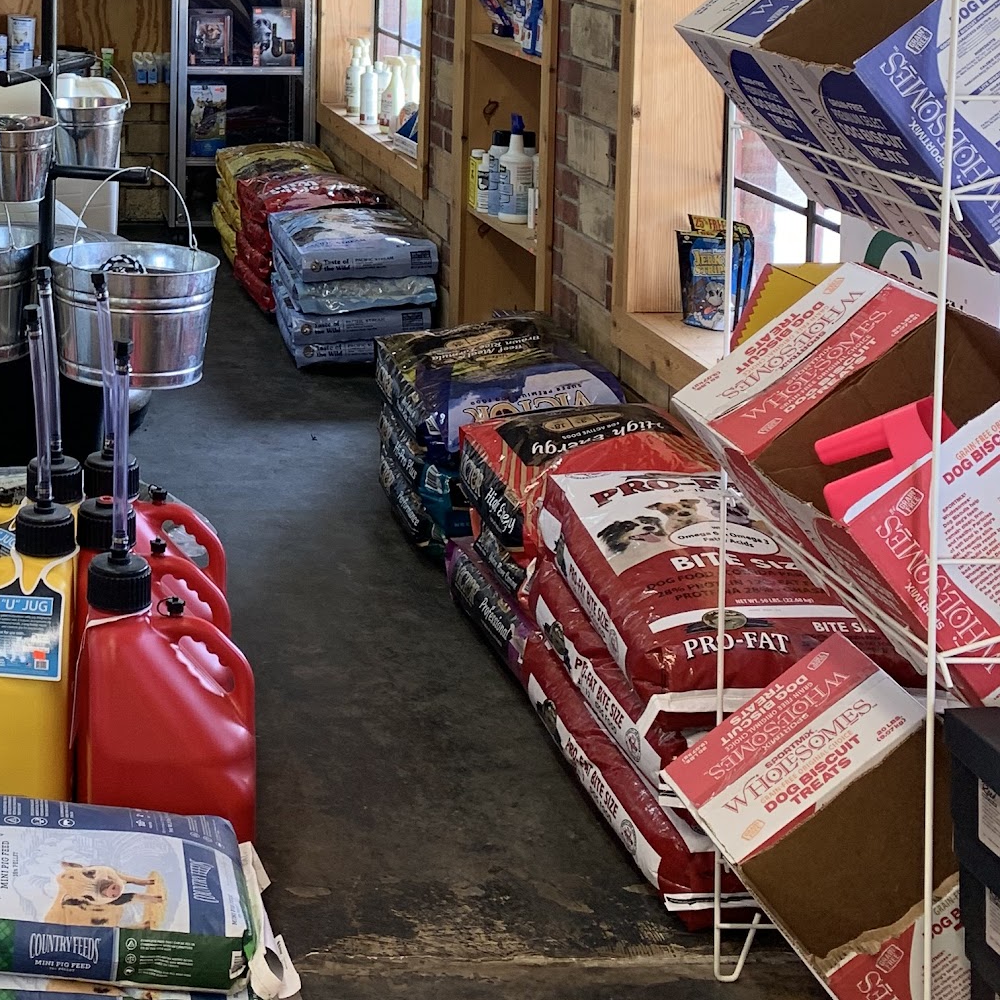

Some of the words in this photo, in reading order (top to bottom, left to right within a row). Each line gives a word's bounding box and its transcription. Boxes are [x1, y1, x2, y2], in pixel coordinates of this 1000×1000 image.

[908, 28, 926, 50] GRAIN
[914, 36, 930, 54] FREE
[794, 301, 824, 328] DOG
[717, 291, 866, 399] WHOLESOMES
[745, 312, 796, 355] TREATS
[845, 334, 872, 359] CHOICE
[735, 328, 793, 375] BISCUIT
[741, 310, 893, 420] WHOLESOMES
[562, 430, 581, 440] DOGS
[582, 425, 606, 436] ACTIVE
[606, 421, 621, 429] FOR
[612, 420, 665, 437] High
[942, 458, 974, 485] DOG
[398, 491, 420, 528] Performance
[485, 487, 500, 514] High
[899, 490, 916, 510] GRAIN
[677, 531, 711, 541] Omega
[730, 532, 763, 545] Omega
[730, 538, 755, 548] Acids
[670, 552, 745, 572] BITE
[646, 576, 676, 591] DOG
[678, 571, 714, 583] FOOD
[22, 601, 48, 612] JUG
[479, 597, 512, 641] Professional
[586, 590, 598, 612] BITE
[597, 608, 610, 632] SIZE
[812, 620, 849, 632] BITE
[683, 631, 790, 660] PRO-FAT
[574, 656, 598, 693] PRO-FAT
[596, 685, 610, 710] BITE
[610, 700, 624, 729] SIZE
[776, 674, 809, 701] DOG
[792, 681, 814, 698] GRAIN
[730, 683, 785, 726] TREATS
[778, 697, 793, 711] FREE
[705, 672, 850, 780] WHOLESOMES
[721, 701, 776, 747] BISCUIT
[750, 709, 778, 735] ORIGINAL
[761, 712, 809, 750] SPORTMIX
[876, 726, 887, 735] 20
[725, 732, 749, 752] CHOICE
[765, 729, 818, 769] SPORTMIX
[798, 750, 829, 777] ORIGINAL
[828, 730, 855, 751] CHOICE
[721, 699, 873, 814] WHOLESOMES
[564, 737, 593, 777] PRO-FAT
[591, 771, 605, 799] BITE
[604, 791, 619, 820] SIZE
[764, 783, 800, 813] DOG
[798, 734, 861, 787] BISCUIT
[790, 757, 852, 805] TREATS
[1, 840, 10, 859] FEED
[1, 860, 9, 872] PIG
[0, 872, 9, 889] MINI
[29, 932, 72, 959] COUNTRY
[72, 937, 102, 964] FEEDS
[34, 959, 56, 968] MINI
[70, 962, 91, 970] FEED
